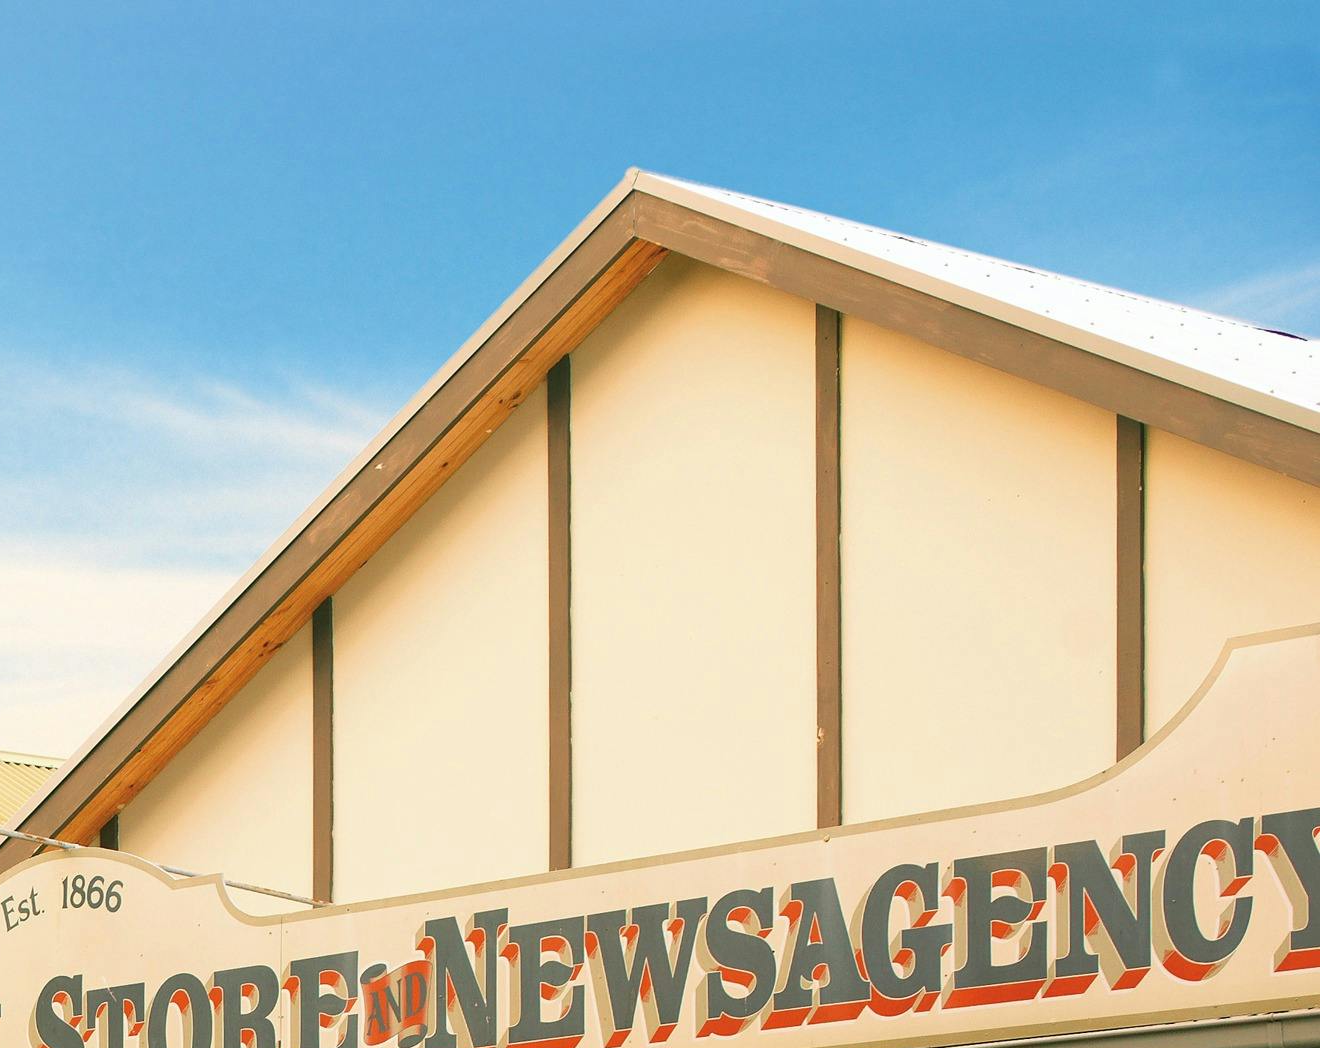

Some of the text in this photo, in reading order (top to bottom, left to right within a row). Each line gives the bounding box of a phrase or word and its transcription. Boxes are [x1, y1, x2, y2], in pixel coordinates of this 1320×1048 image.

[0, 873, 124, 932] Est. 1866
[365, 970, 430, 1038] AND
